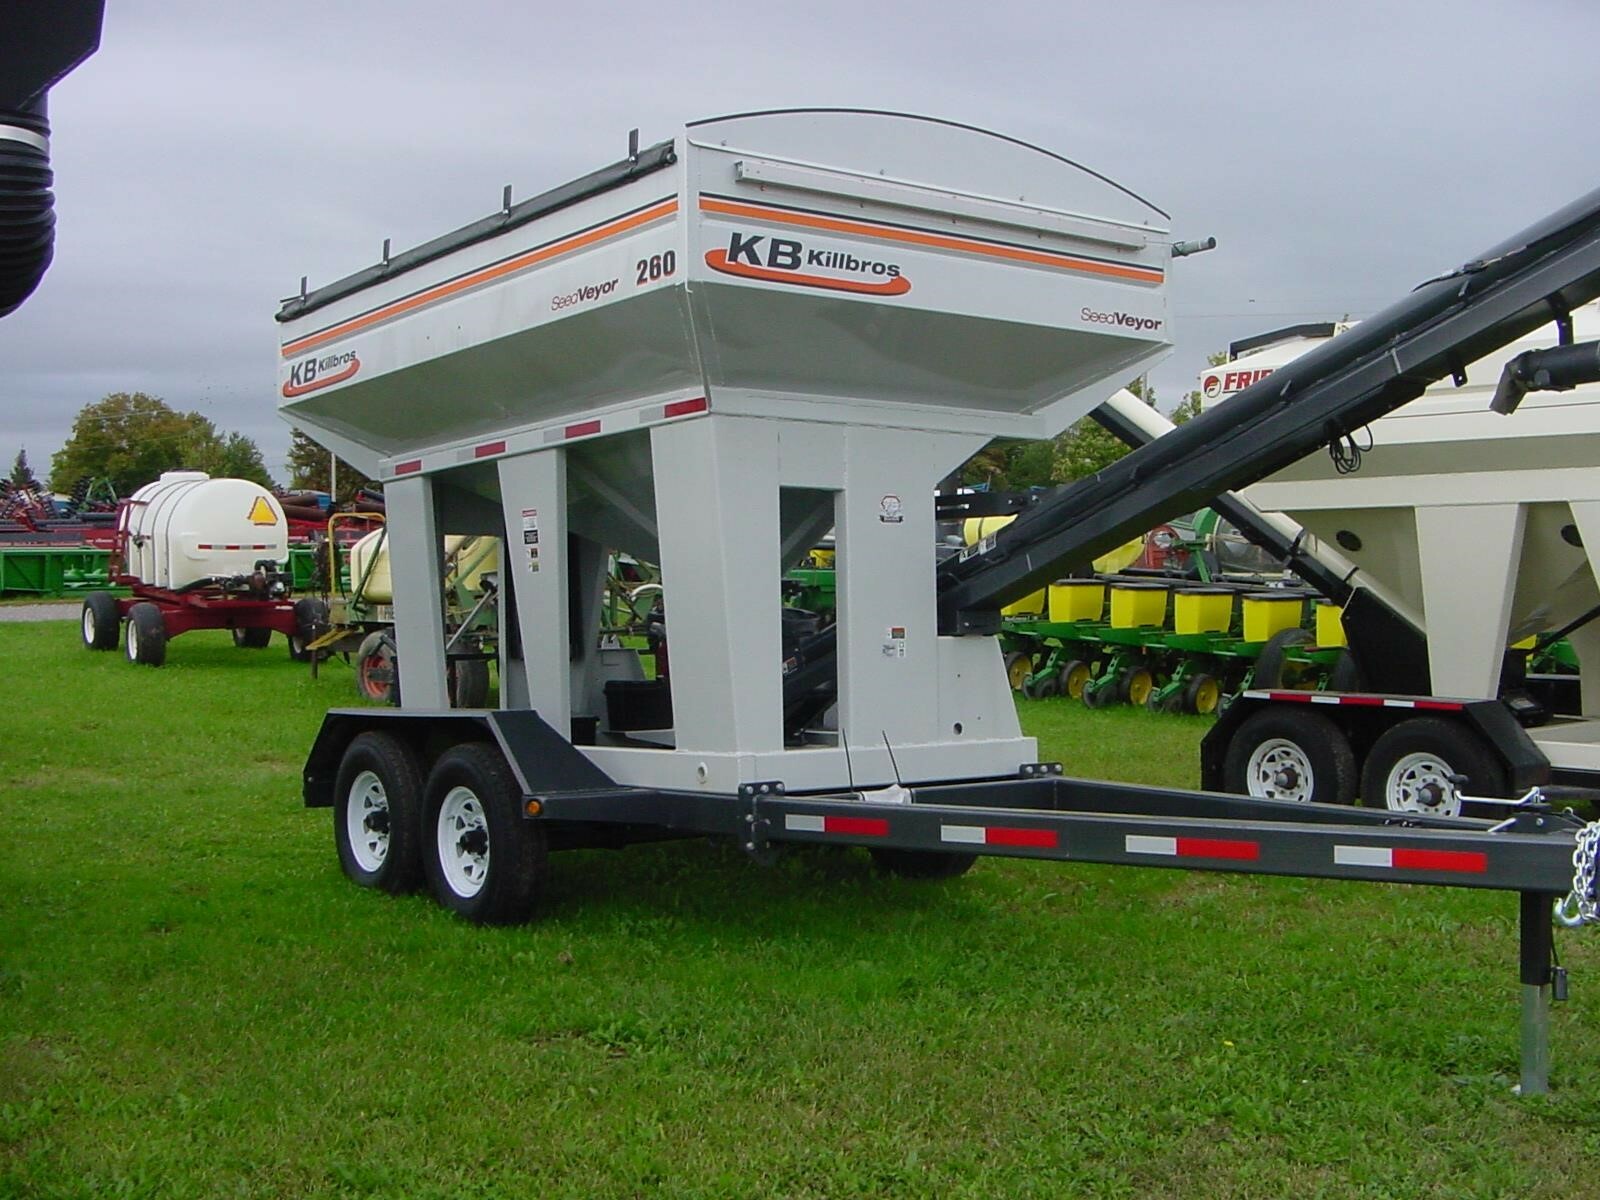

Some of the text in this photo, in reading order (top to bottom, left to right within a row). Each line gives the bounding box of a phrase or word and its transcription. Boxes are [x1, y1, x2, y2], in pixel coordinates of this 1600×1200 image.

[636, 250, 676, 286] 260
[727, 232, 901, 277] KB Killbros
[290, 350, 357, 388] KB Killbros
